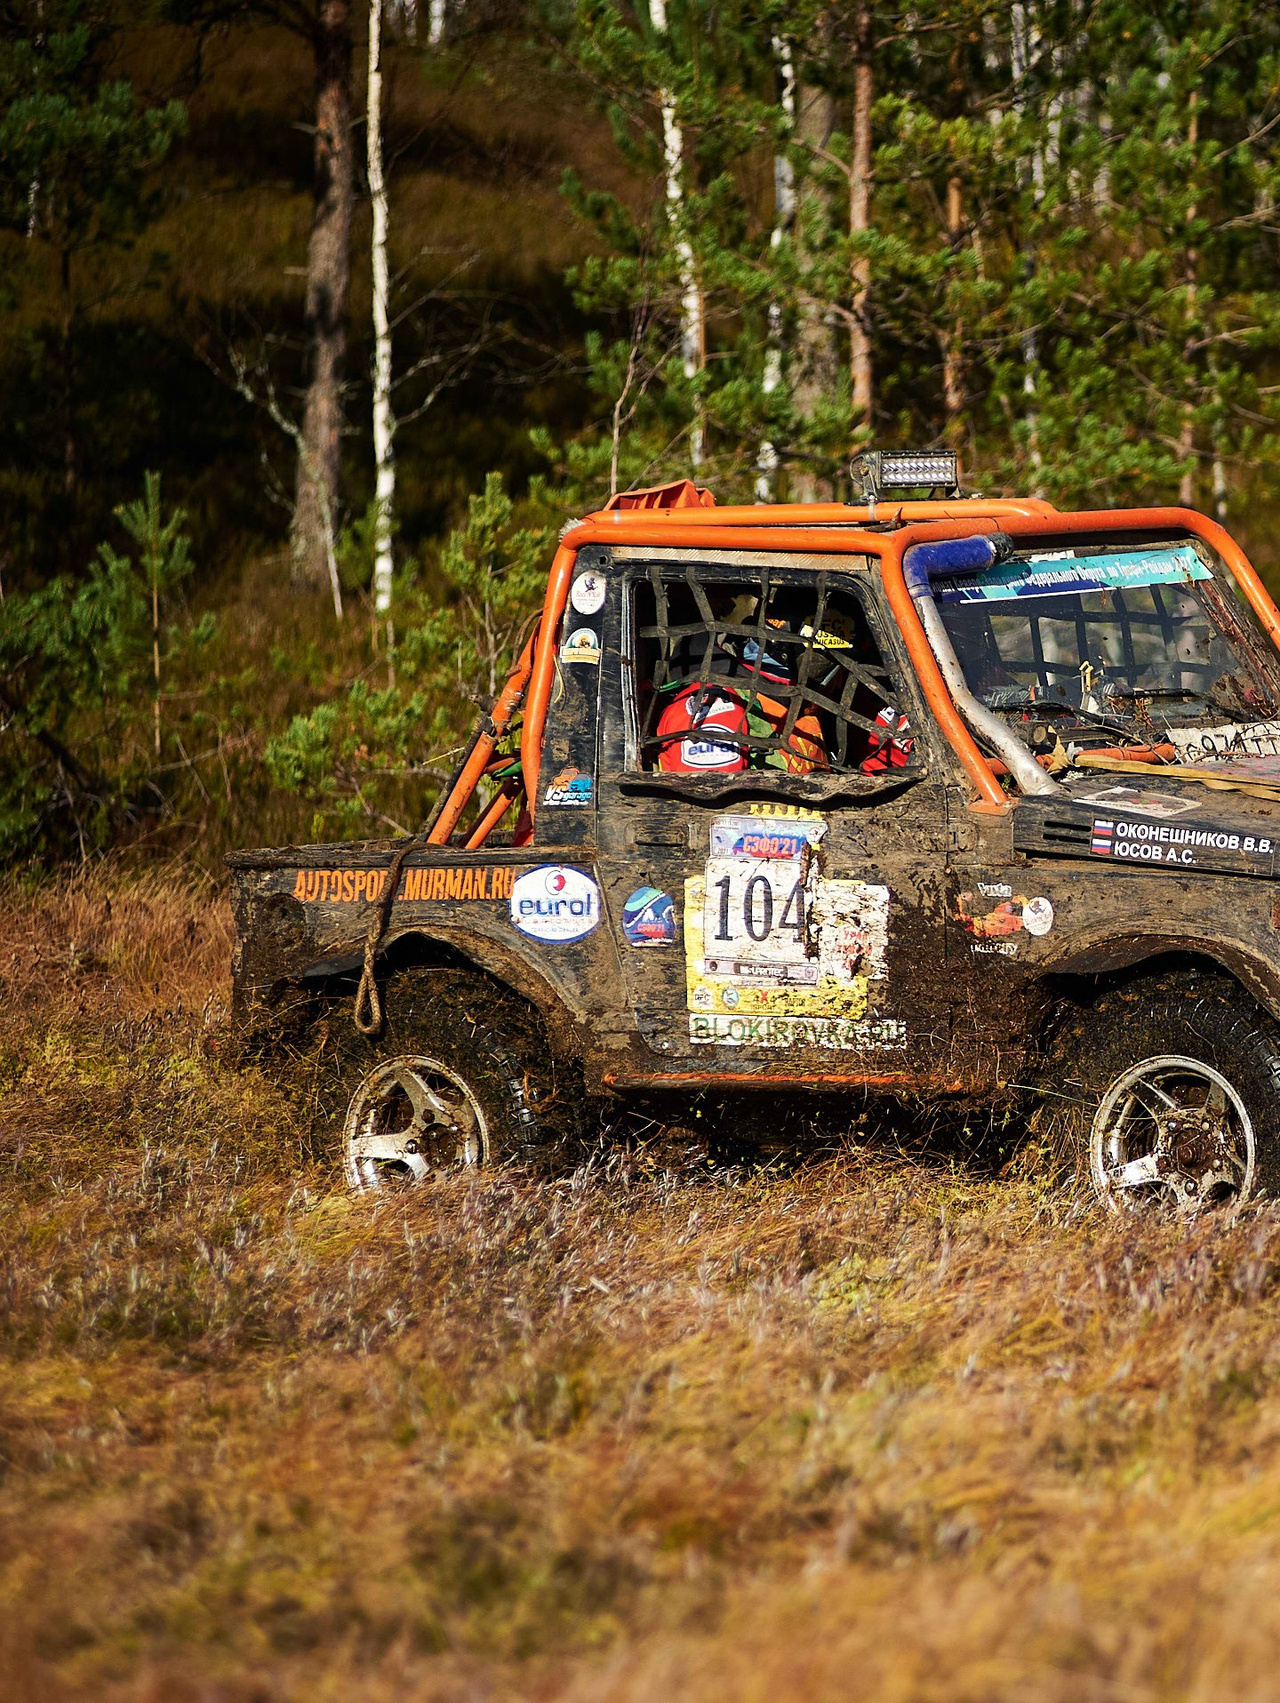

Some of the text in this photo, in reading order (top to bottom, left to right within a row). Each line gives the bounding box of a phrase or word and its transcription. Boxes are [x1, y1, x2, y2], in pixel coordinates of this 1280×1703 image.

[1076, 564, 1107, 583] Округа
[743, 835, 797, 855] СЗФО'21
[1116, 821, 1275, 854] ОКОНЕШНИКОВ В.В.
[1113, 840, 1197, 864] ЮСОВ А.С.
[519, 893, 591, 916] eurol
[714, 874, 805, 942] 104
